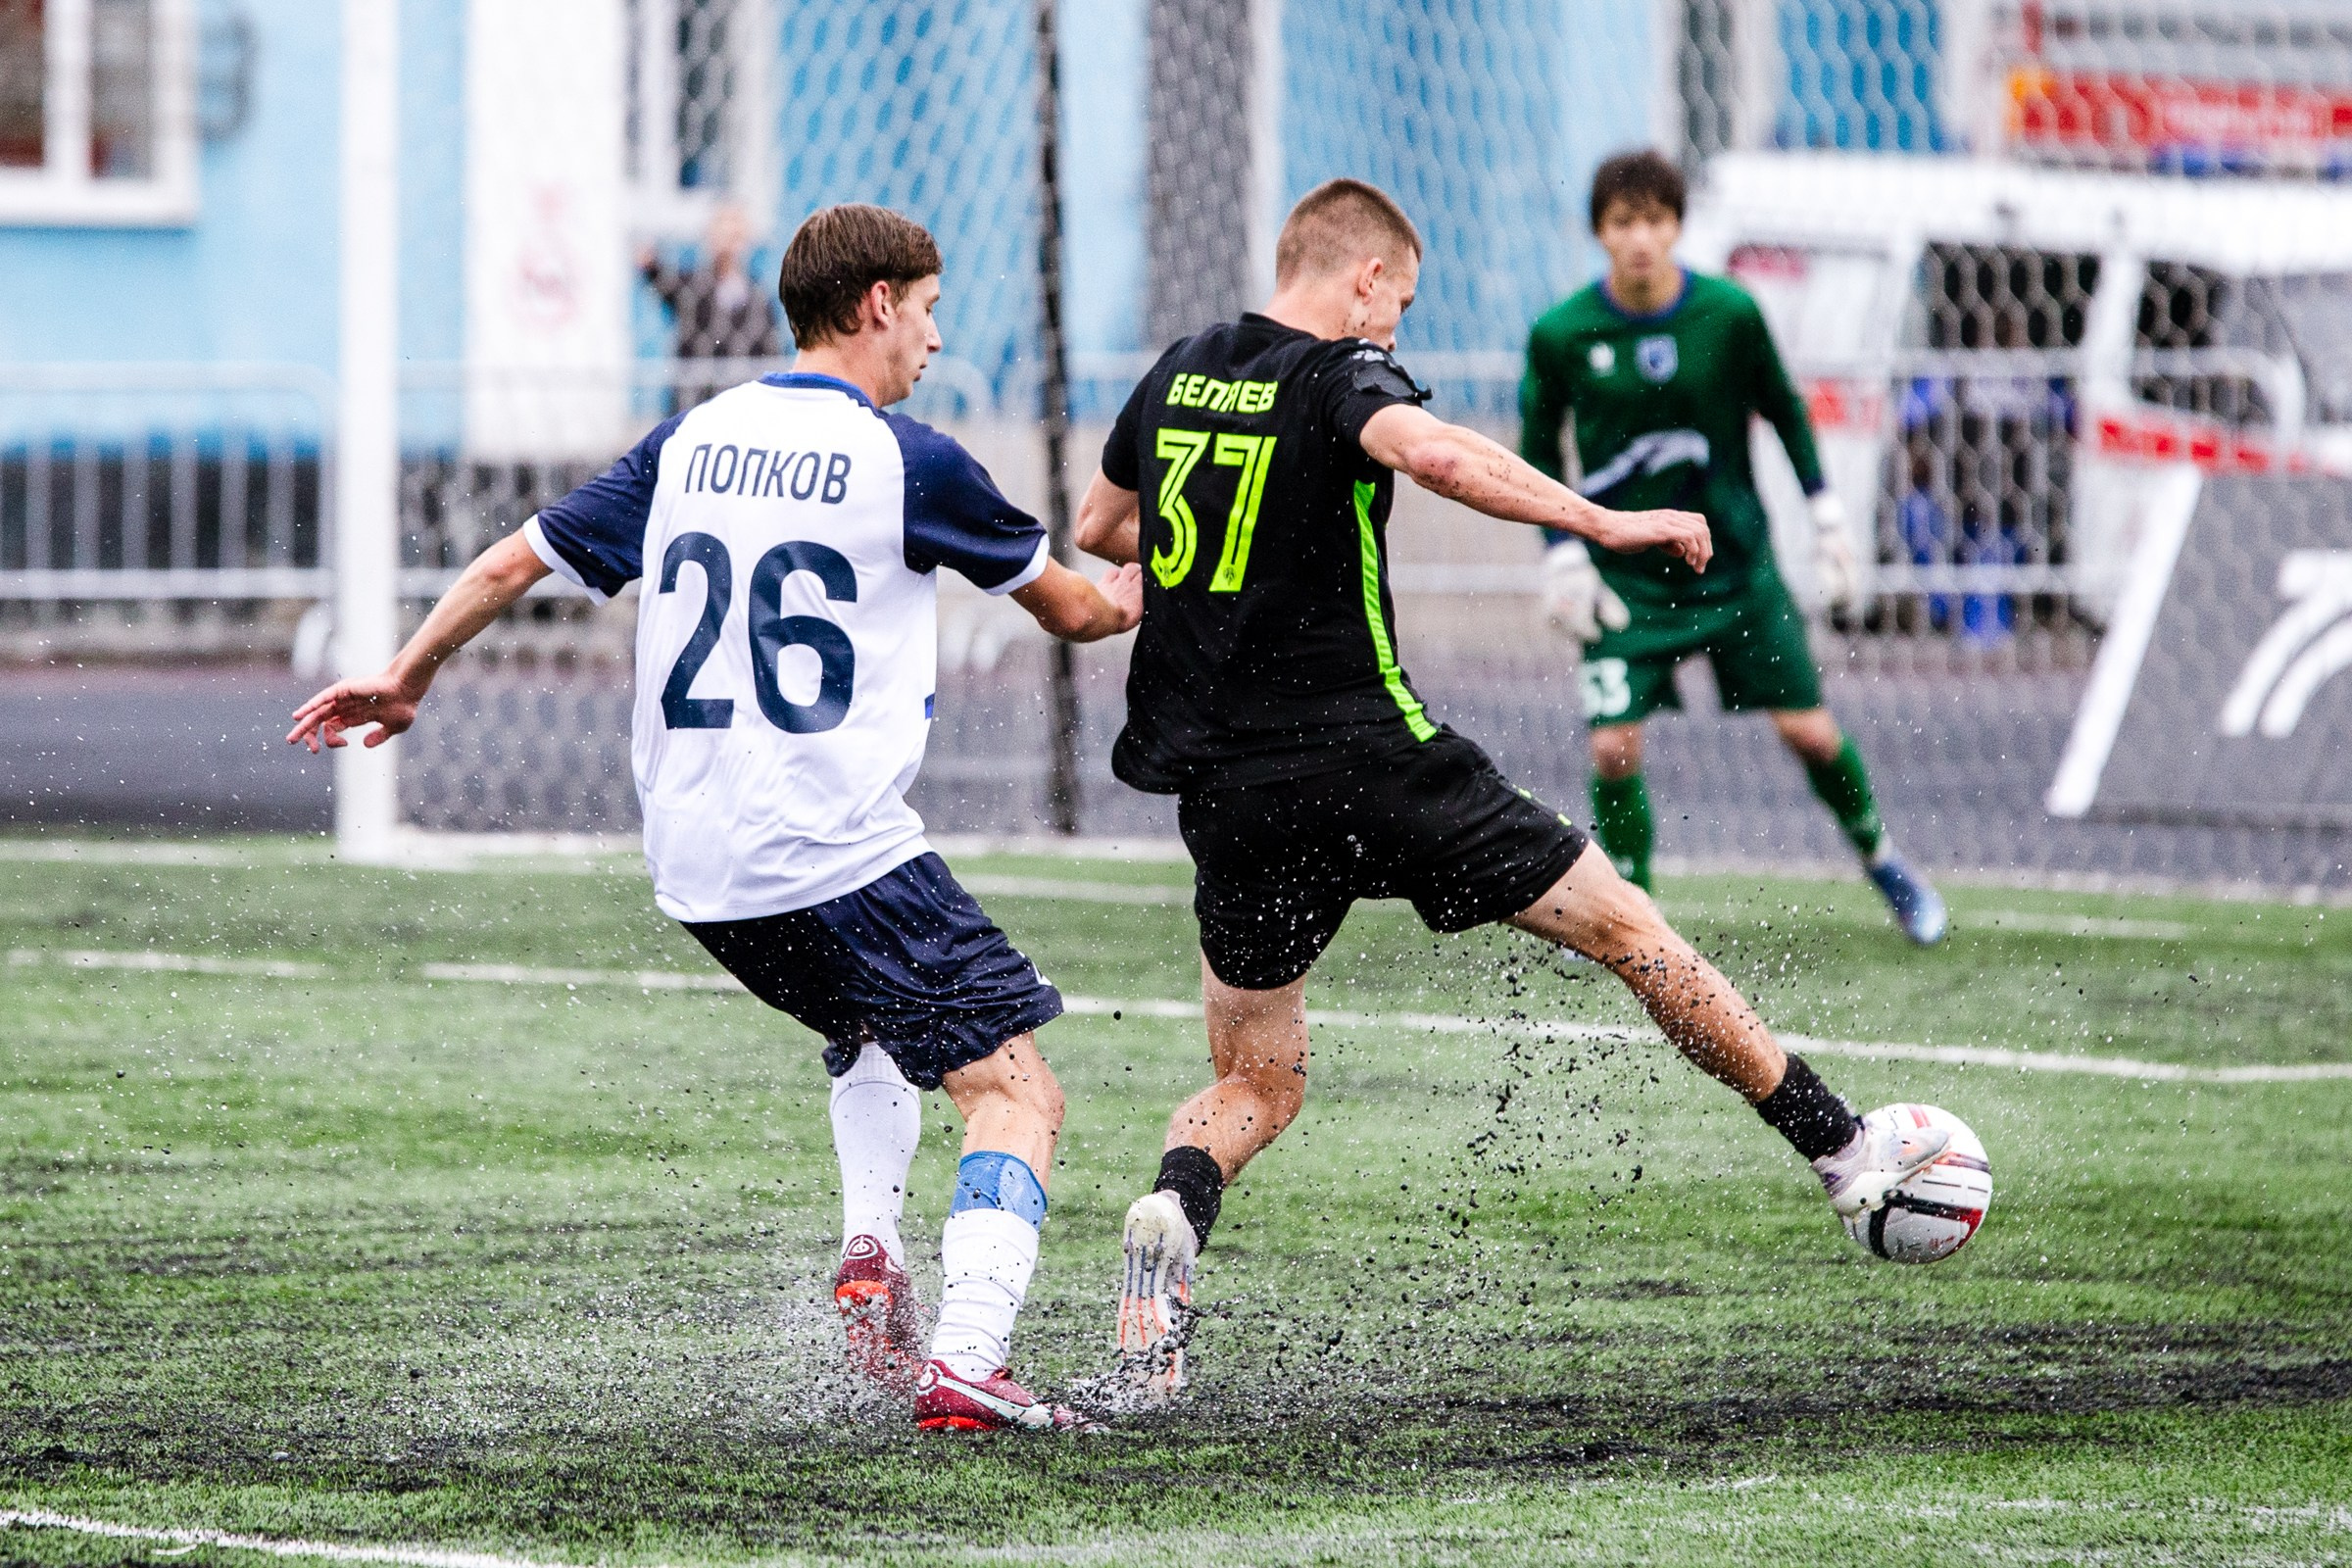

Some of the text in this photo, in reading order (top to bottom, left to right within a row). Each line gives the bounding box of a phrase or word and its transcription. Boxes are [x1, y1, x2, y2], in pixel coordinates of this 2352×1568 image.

[1166, 372, 1278, 414] БЕЛЯЕВ
[685, 443, 852, 505] ПОПКОВ
[1151, 427, 1277, 592] 37
[659, 530, 858, 734] 26
